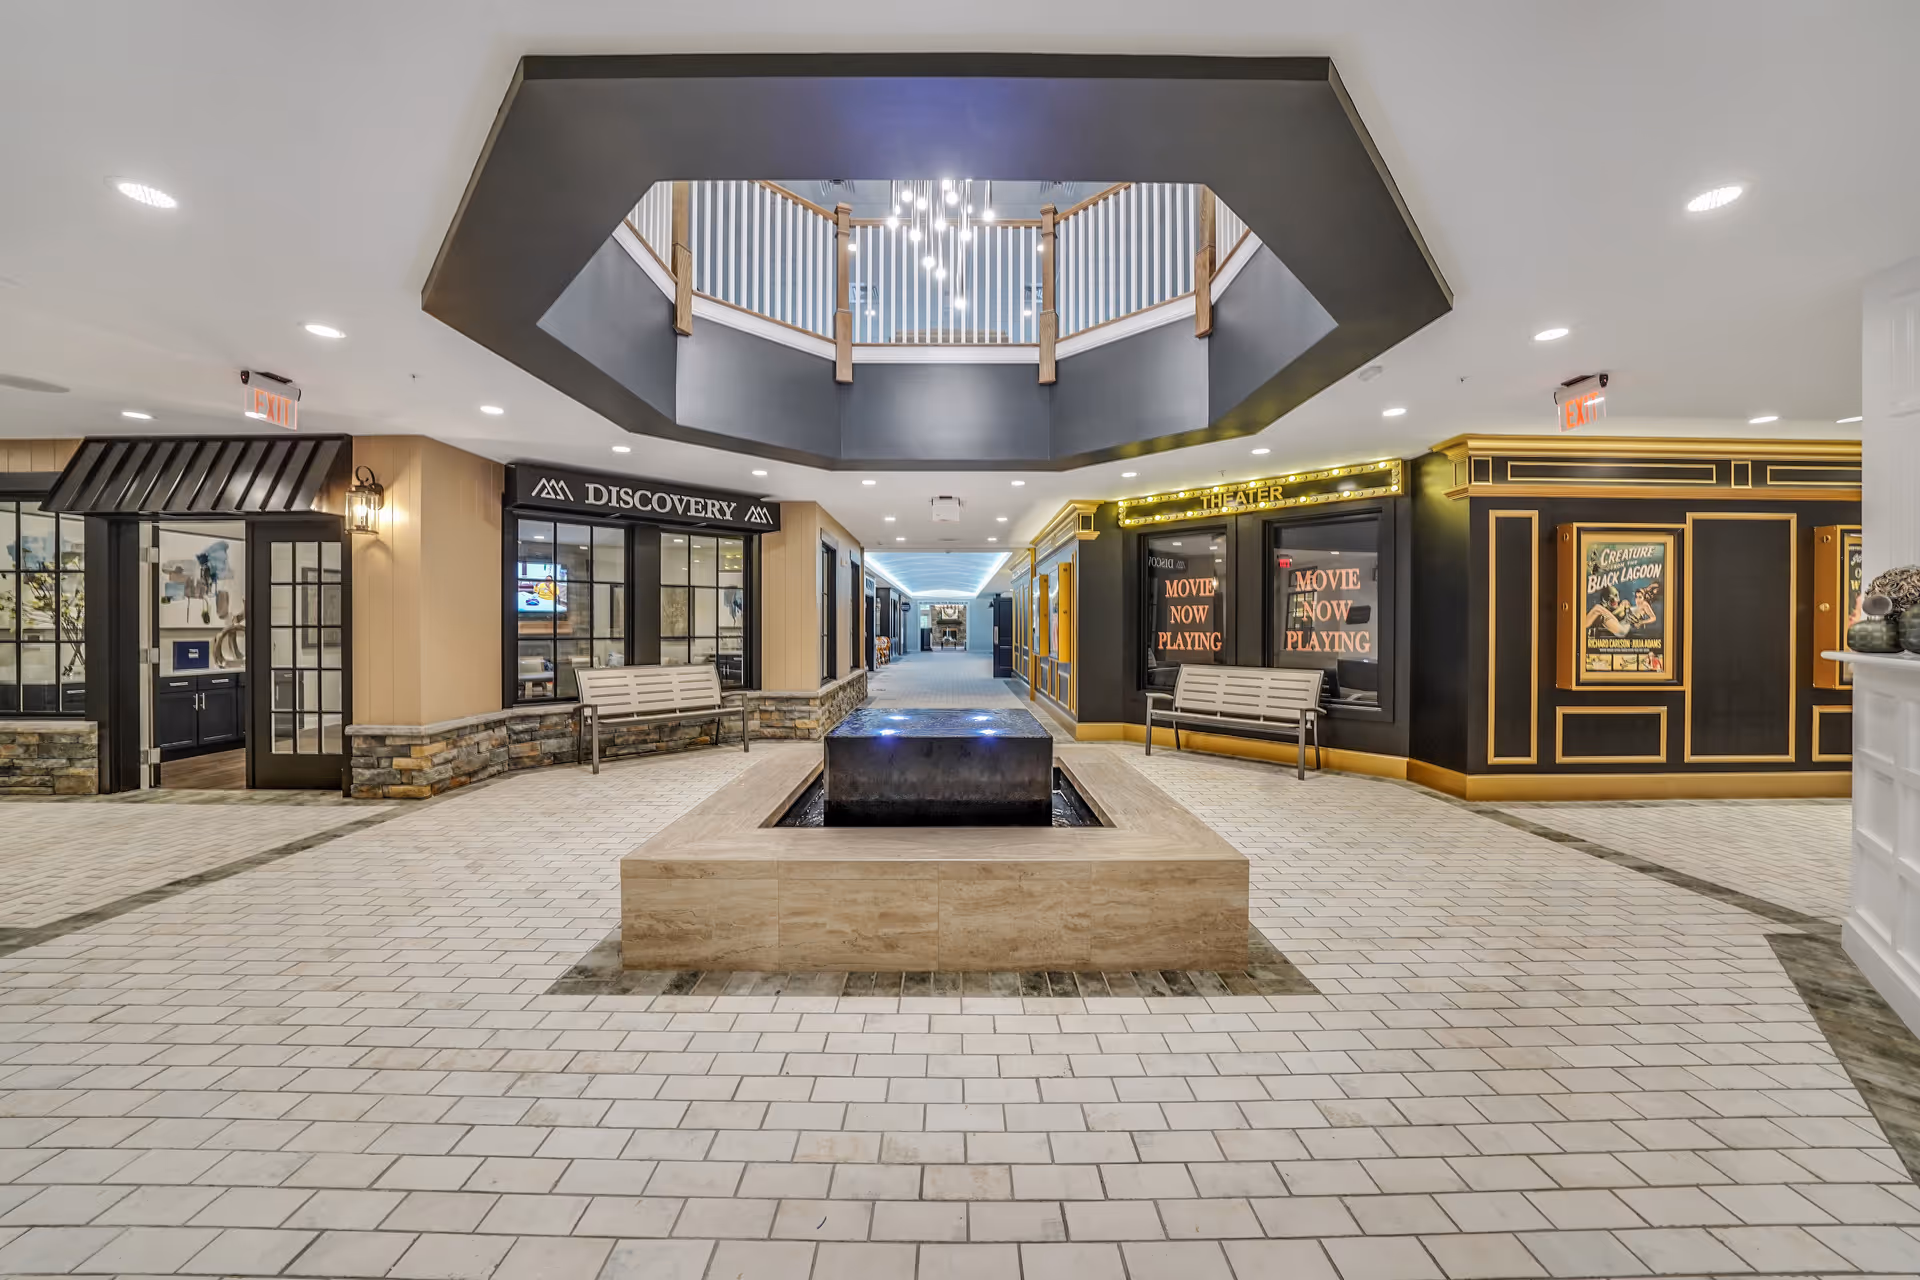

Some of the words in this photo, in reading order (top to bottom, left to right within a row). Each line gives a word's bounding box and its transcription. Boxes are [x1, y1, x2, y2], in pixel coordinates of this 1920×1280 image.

[254, 388, 291, 426] EXIT
[1565, 391, 1599, 430] EXIT
[585, 483, 737, 520] DISCOVERY
[1200, 486, 1283, 510] THEATER
[1601, 546, 1655, 566] CREATURE
[1165, 578, 1215, 597] MOVIE
[1295, 568, 1360, 592] MOVIE
[1588, 571, 1620, 595] BLACK
[1620, 564, 1662, 583] LAGOON
[1169, 605, 1209, 624] NOW
[1301, 600, 1354, 622] NOW
[1158, 631, 1222, 651] PLAYING
[1286, 631, 1371, 653] PLAYING
